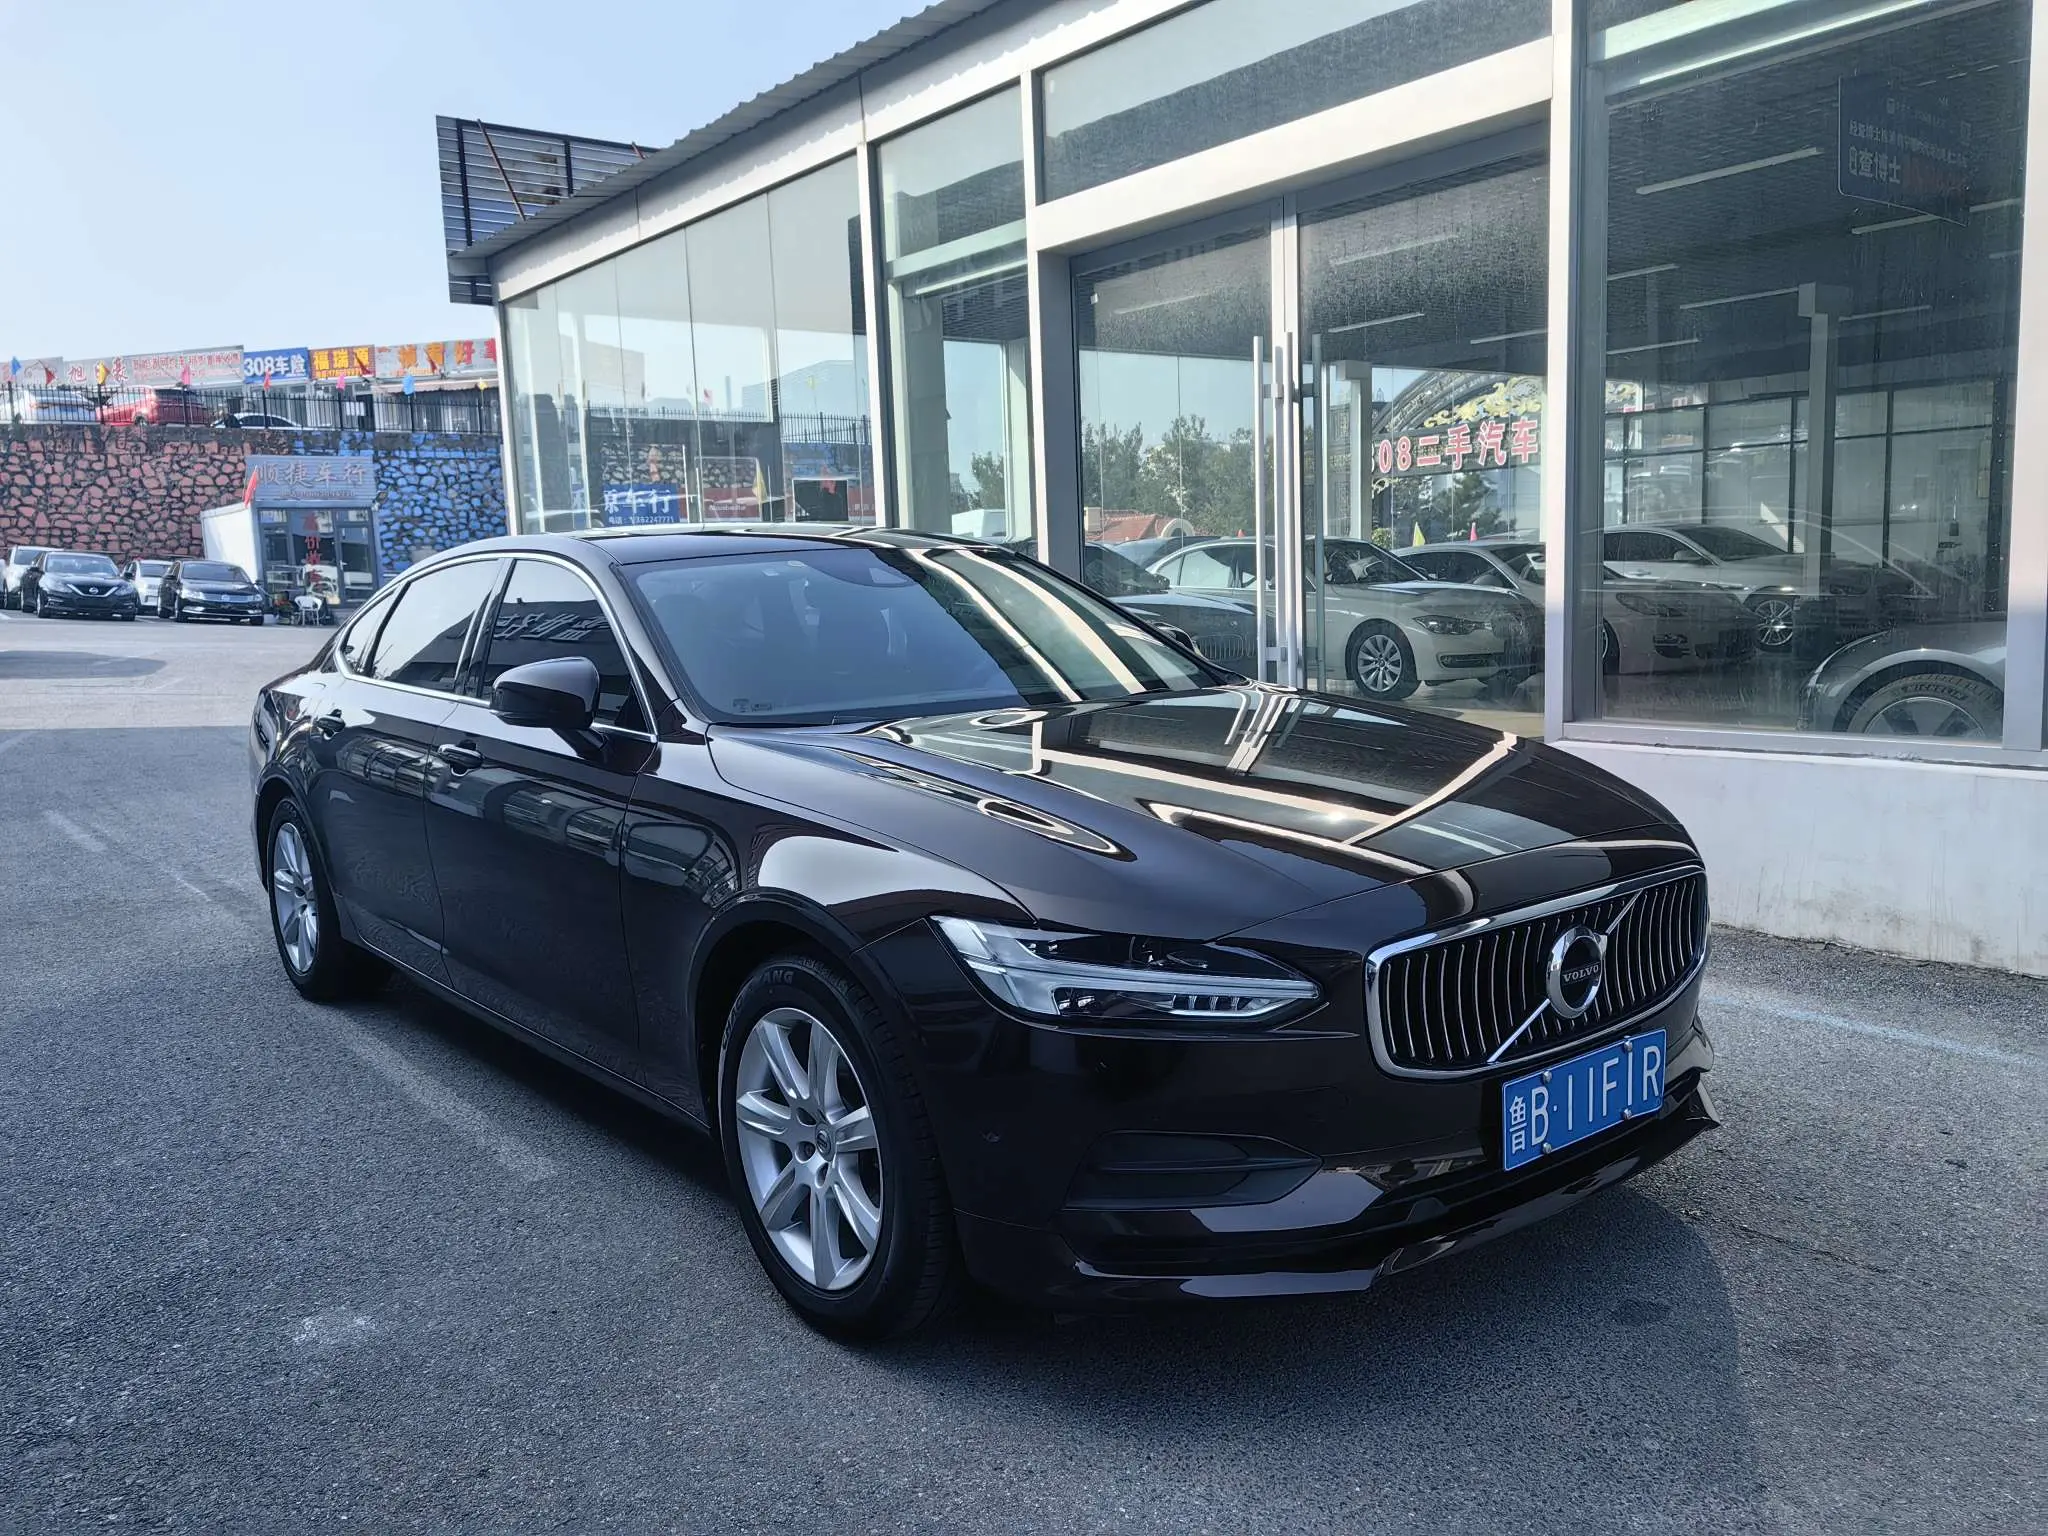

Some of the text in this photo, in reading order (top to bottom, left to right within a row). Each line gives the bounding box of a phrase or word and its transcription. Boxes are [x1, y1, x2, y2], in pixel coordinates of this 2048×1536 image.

[1371, 417, 1538, 474] 08二手汽车
[257, 461, 366, 488] 顺捷车行
[1562, 963, 1601, 984] VOLVO
